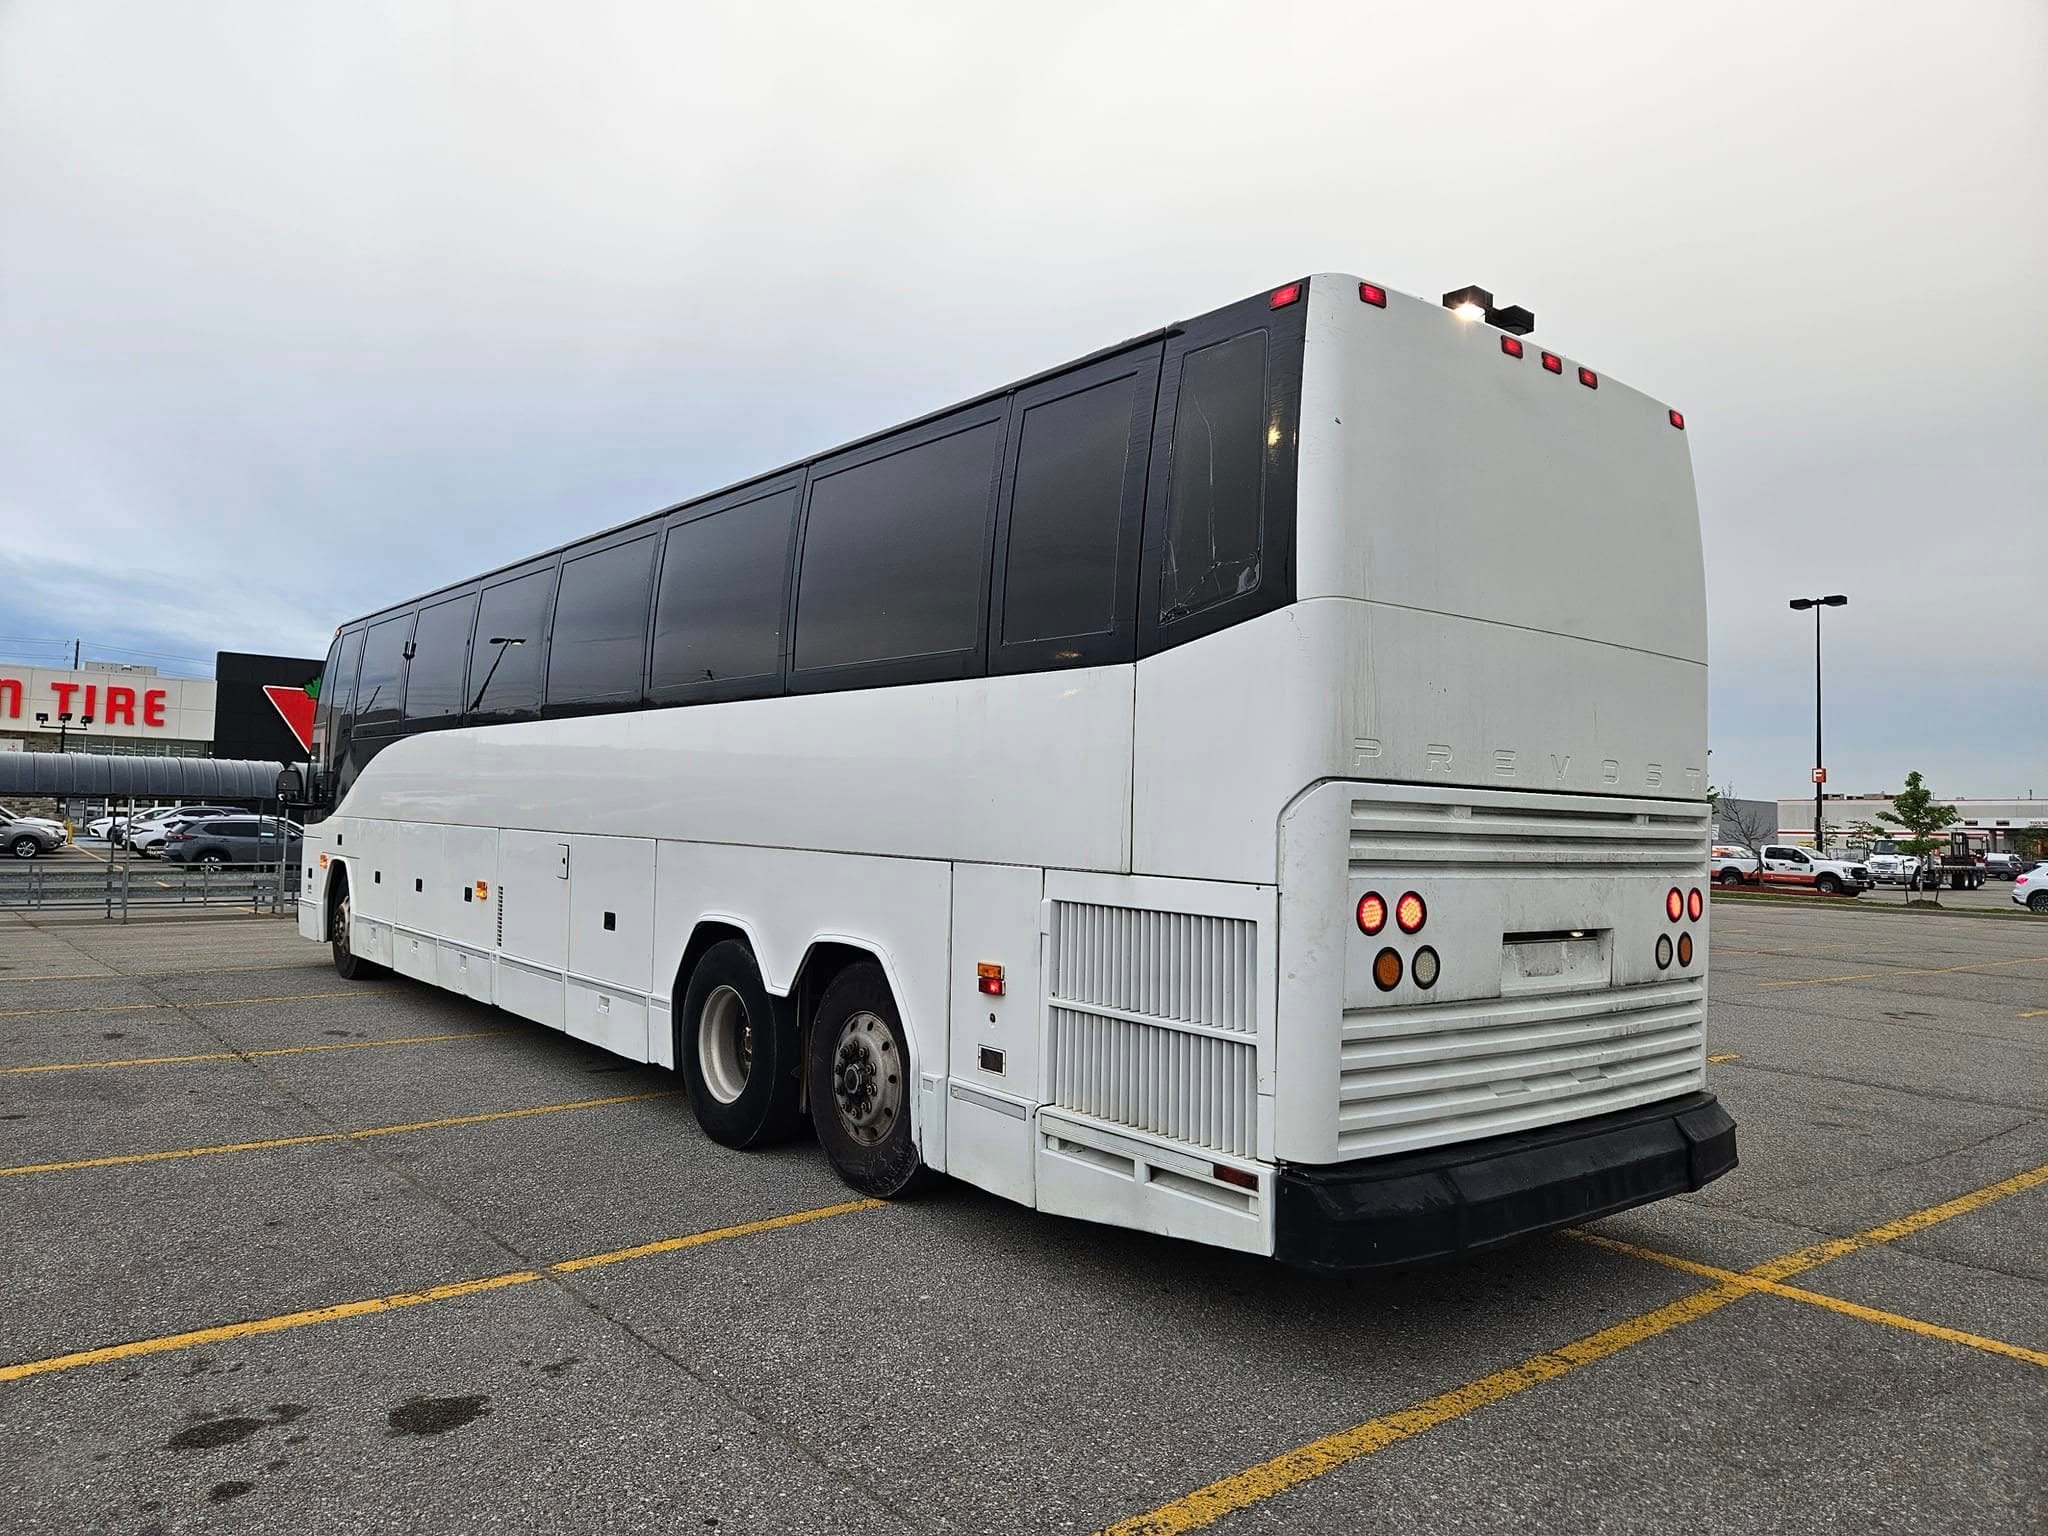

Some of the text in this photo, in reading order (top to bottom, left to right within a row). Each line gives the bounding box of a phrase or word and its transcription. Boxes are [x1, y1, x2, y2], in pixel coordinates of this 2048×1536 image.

[51, 682, 167, 727] TIRE
[1353, 737, 1701, 792] PREVOST
[1813, 769, 1823, 782] F
